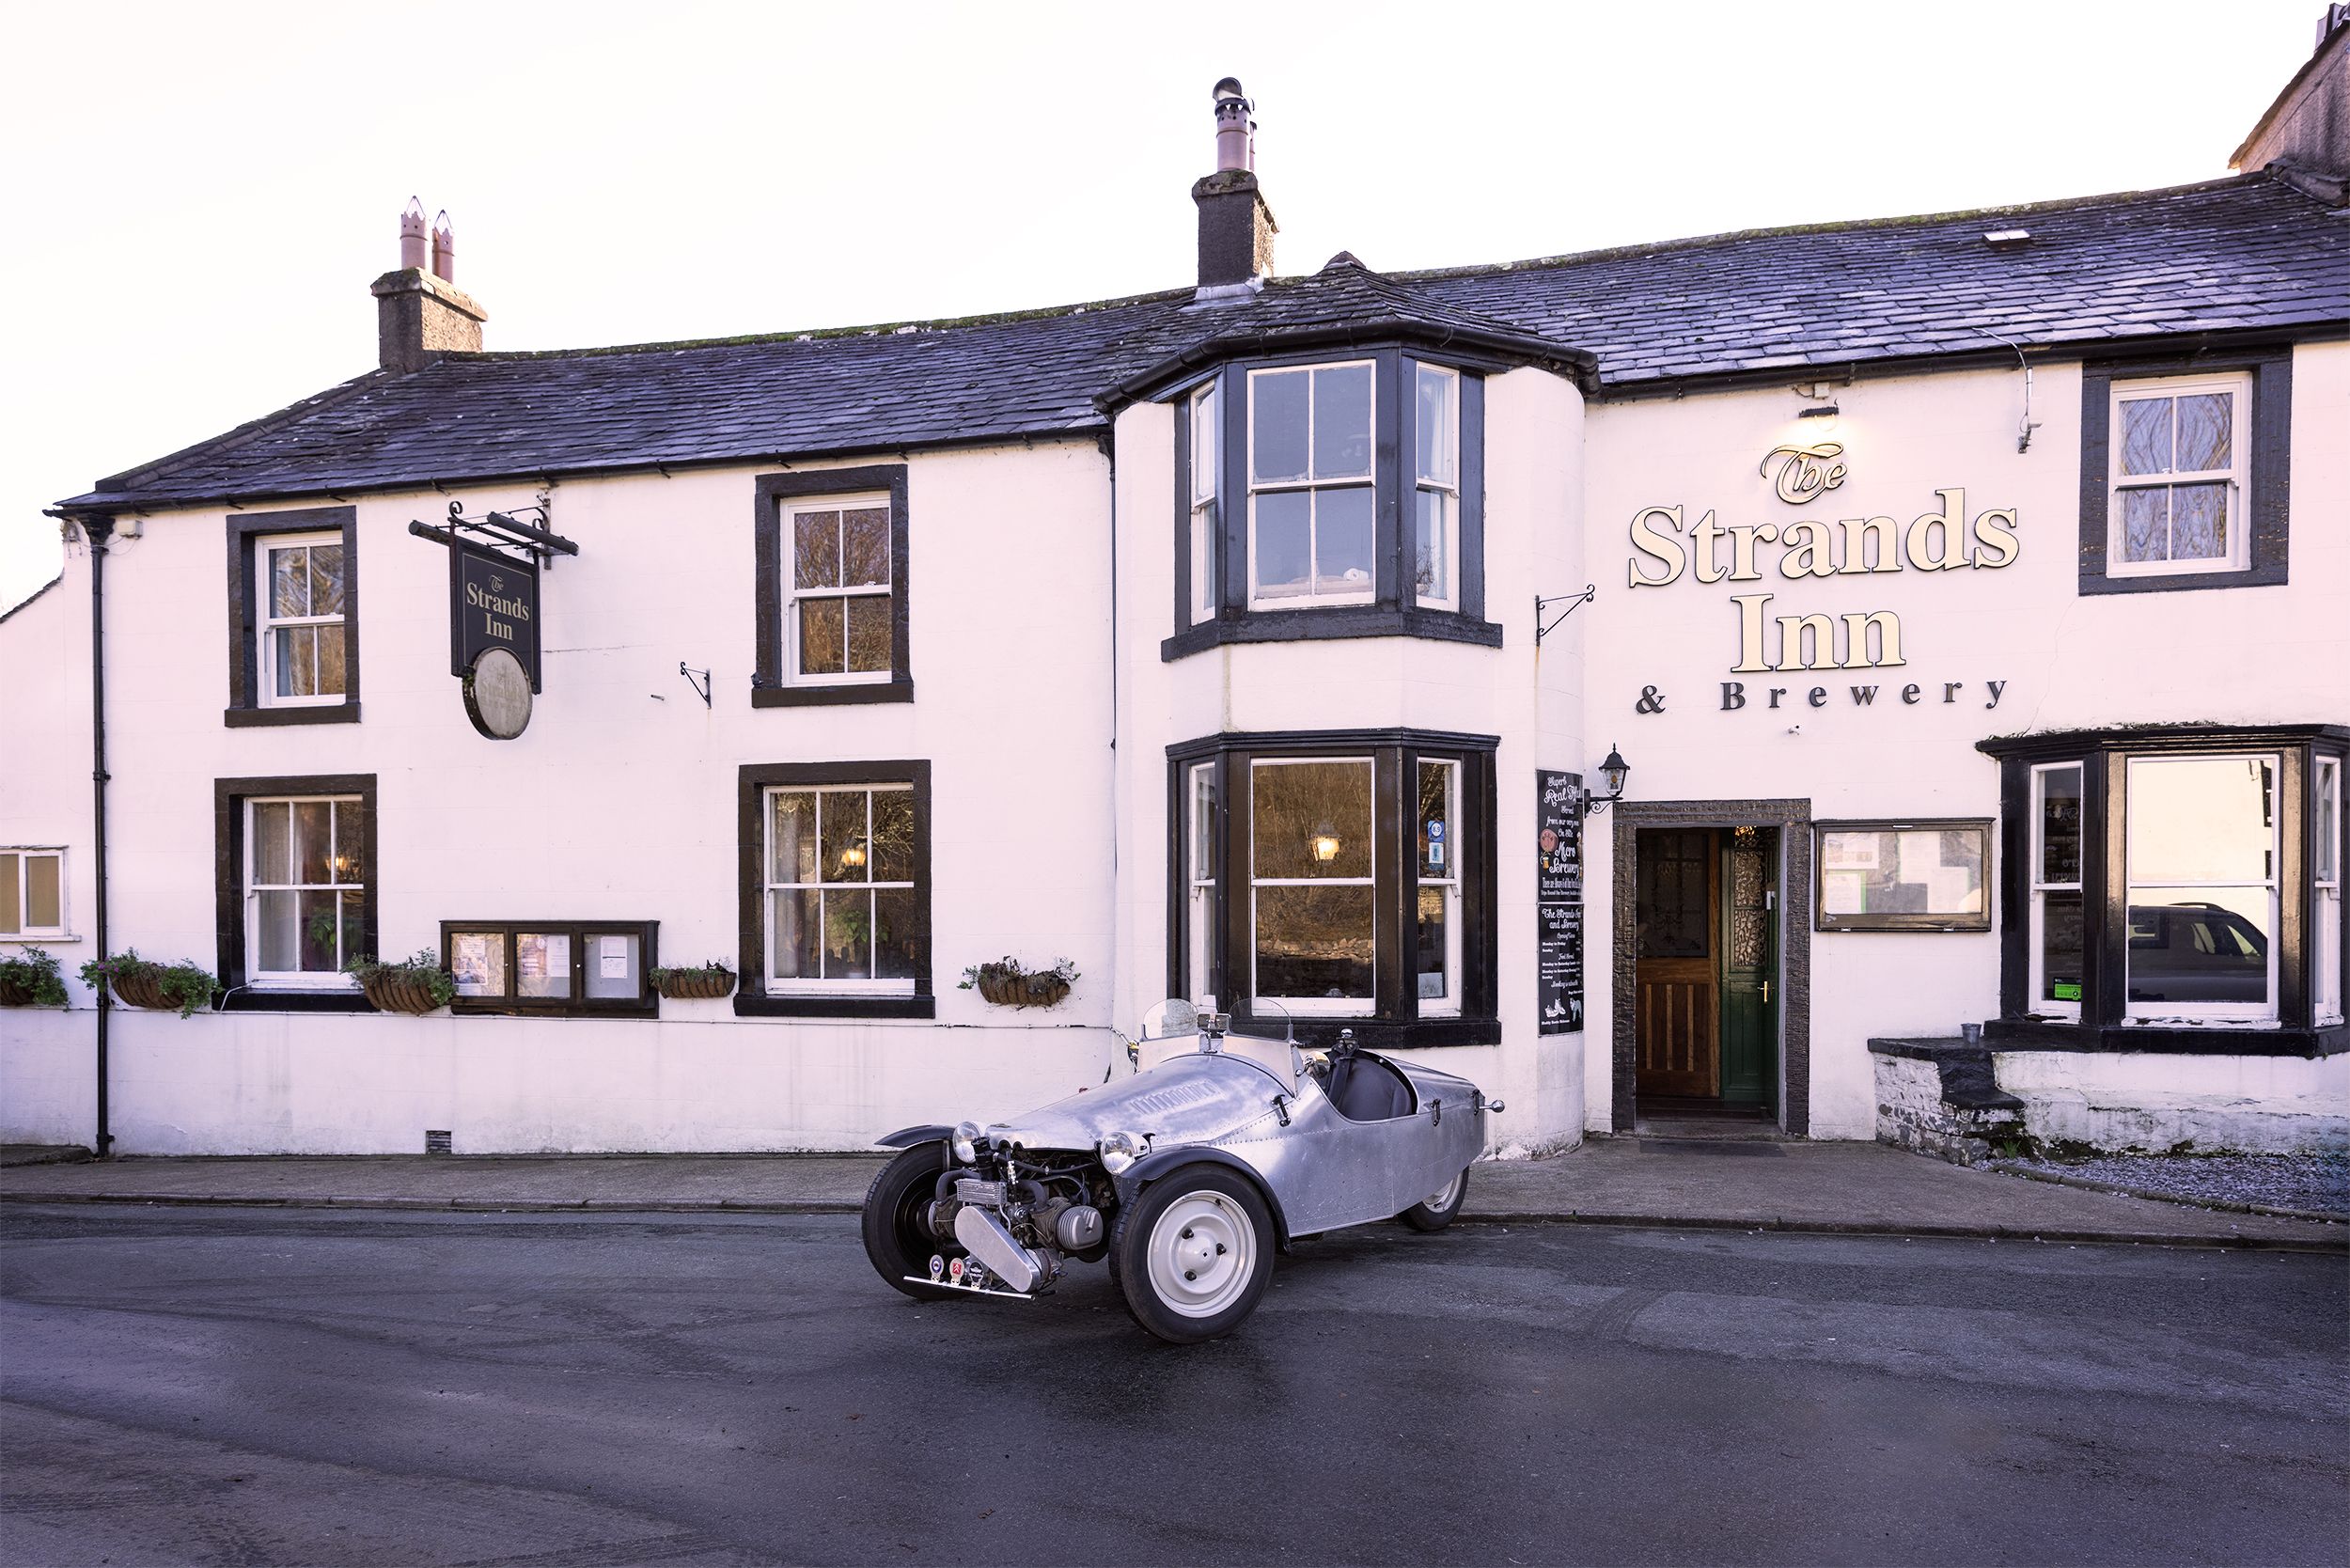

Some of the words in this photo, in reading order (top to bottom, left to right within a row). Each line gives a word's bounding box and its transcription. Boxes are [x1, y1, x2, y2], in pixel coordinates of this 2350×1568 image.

[1760, 441, 1848, 505] The
[1628, 487, 2021, 588] Strands
[489, 574, 505, 592] The
[466, 582, 530, 621] Strands
[484, 612, 514, 641] Inn
[1730, 593, 1907, 673] Inn
[1636, 684, 1666, 715] &
[1719, 680, 2008, 710] Brewery
[1543, 788, 1567, 807] Real
[1549, 857, 1580, 879] Brewery
[1542, 908, 1556, 918] The
